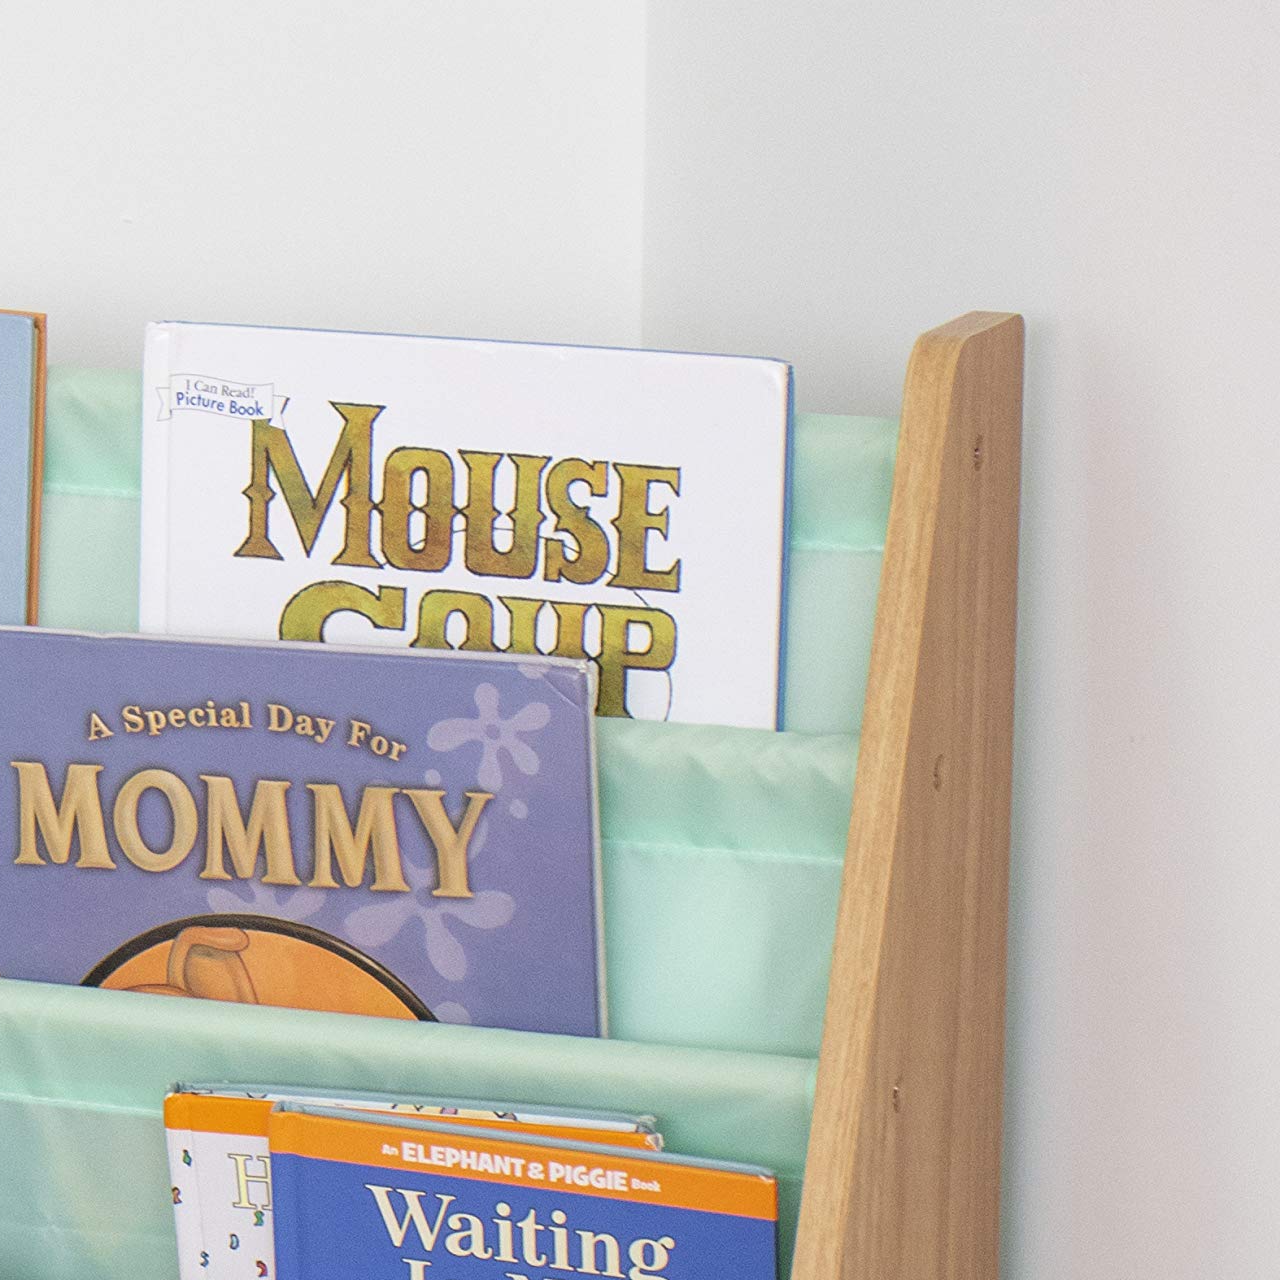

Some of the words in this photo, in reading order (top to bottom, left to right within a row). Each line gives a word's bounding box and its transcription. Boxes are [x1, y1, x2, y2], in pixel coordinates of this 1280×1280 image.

[176, 391, 225, 412] Picture
[229, 400, 264, 416] Book
[193, 380, 218, 395] Can
[221, 384, 255, 399] Read!
[233, 401, 682, 593] MOUSE
[86, 711, 114, 742] A
[121, 700, 253, 737] Special
[266, 703, 336, 745] Day
[348, 720, 408, 762] For
[9, 760, 496, 899] MOMMY
[381, 1144, 400, 1157] An
[401, 1141, 526, 1179] ELEPHANT
[527, 1159, 546, 1181] &
[548, 1160, 629, 1193] PIGGIE
[631, 1177, 661, 1194] Book
